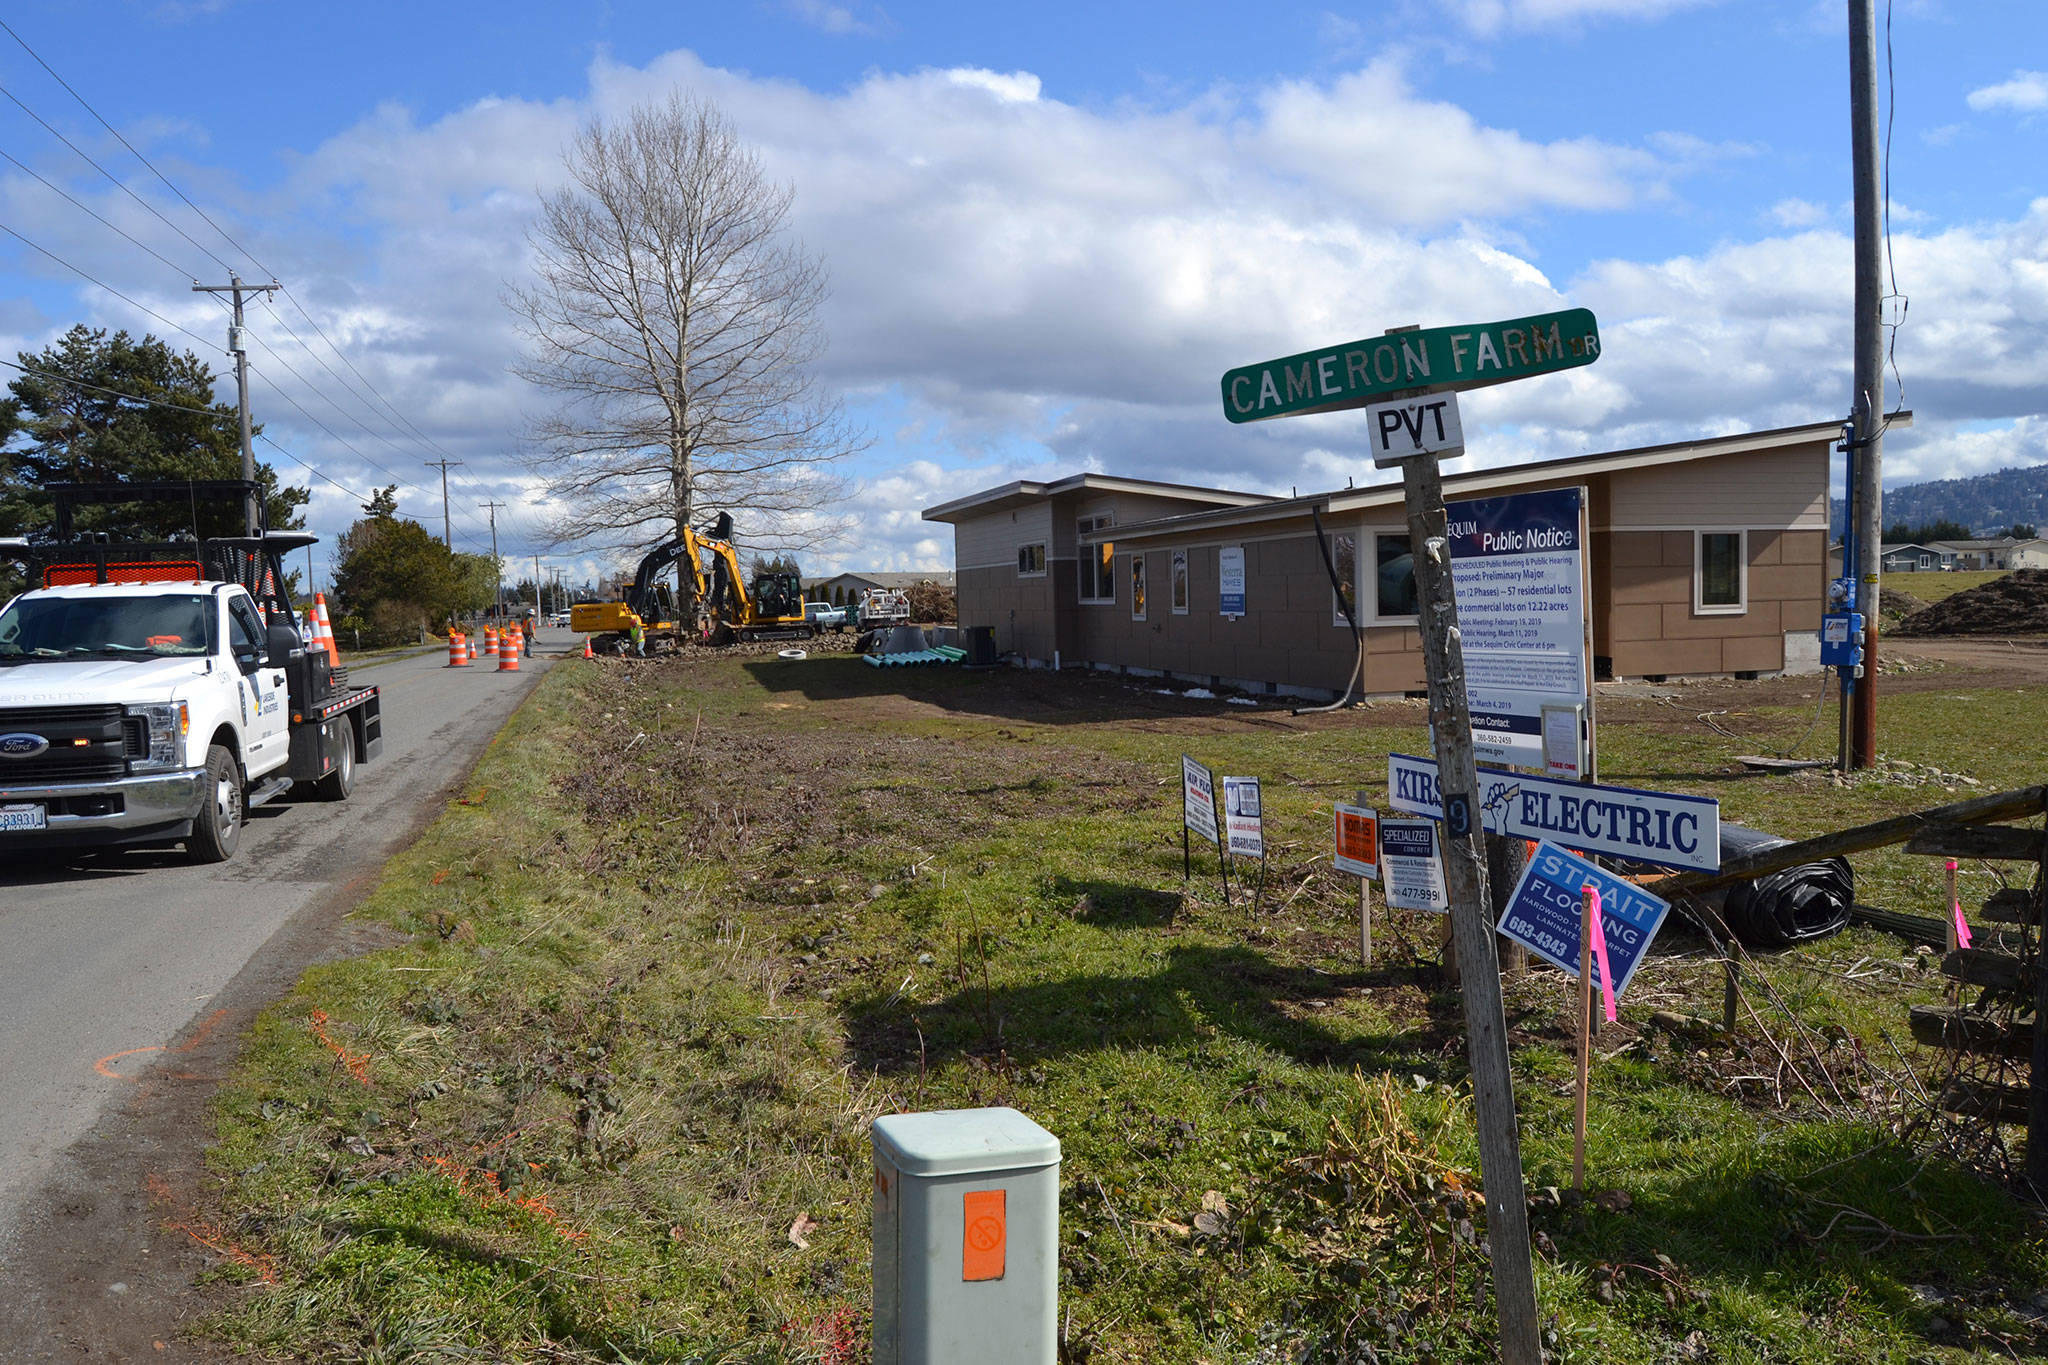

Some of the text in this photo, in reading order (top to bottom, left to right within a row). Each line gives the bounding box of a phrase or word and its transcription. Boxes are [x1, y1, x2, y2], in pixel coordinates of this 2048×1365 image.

[1231, 321, 1598, 414] CAMERON FARM DR
[1377, 401, 1448, 450] PVT
[1447, 521, 1477, 539] EQUIM
[1483, 527, 1573, 552] Public Notice
[669, 544, 686, 557] DEE
[1502, 559, 1525, 569] Meeting
[1531, 557, 1548, 565] Public
[1549, 556, 1573, 566] Hearing
[1453, 569, 1544, 583] roposed: Preliminary Major
[1474, 587, 1500, 597] Phases)
[1508, 586, 1516, 596] 57
[1517, 585, 1556, 595] residential
[1557, 585, 1572, 594] lots
[1464, 602, 1501, 612] commercial
[1502, 603, 1516, 612] lots
[1517, 604, 1526, 612] on
[1528, 601, 1548, 611] 12.22
[1549, 602, 1569, 611] acres
[1460, 618, 1472, 626] ublic
[1495, 618, 1518, 627] February
[1498, 629, 1514, 637] March
[1483, 641, 1503, 650] Sequim
[1476, 700, 1492, 708] March
[1498, 701, 1511, 709] 2019
[4, 740, 32, 752] Ford
[1550, 761, 1564, 769] TAKE
[1187, 772, 1211, 794] AIR FLO
[1451, 800, 1469, 832] 9
[1520, 789, 1699, 854] ELECTRIC
[1384, 829, 1430, 843] SPECIALIZED
[1403, 845, 1431, 854] CONCRETE
[1691, 855, 1704, 864] INC
[1542, 855, 1654, 922] STRAIT
[1522, 896, 1569, 924] HARDWOOD
[1530, 879, 1639, 945] FLOOING
[1509, 916, 1568, 957] 683-4343
[1536, 914, 1631, 958] LAMINATE ARPET
